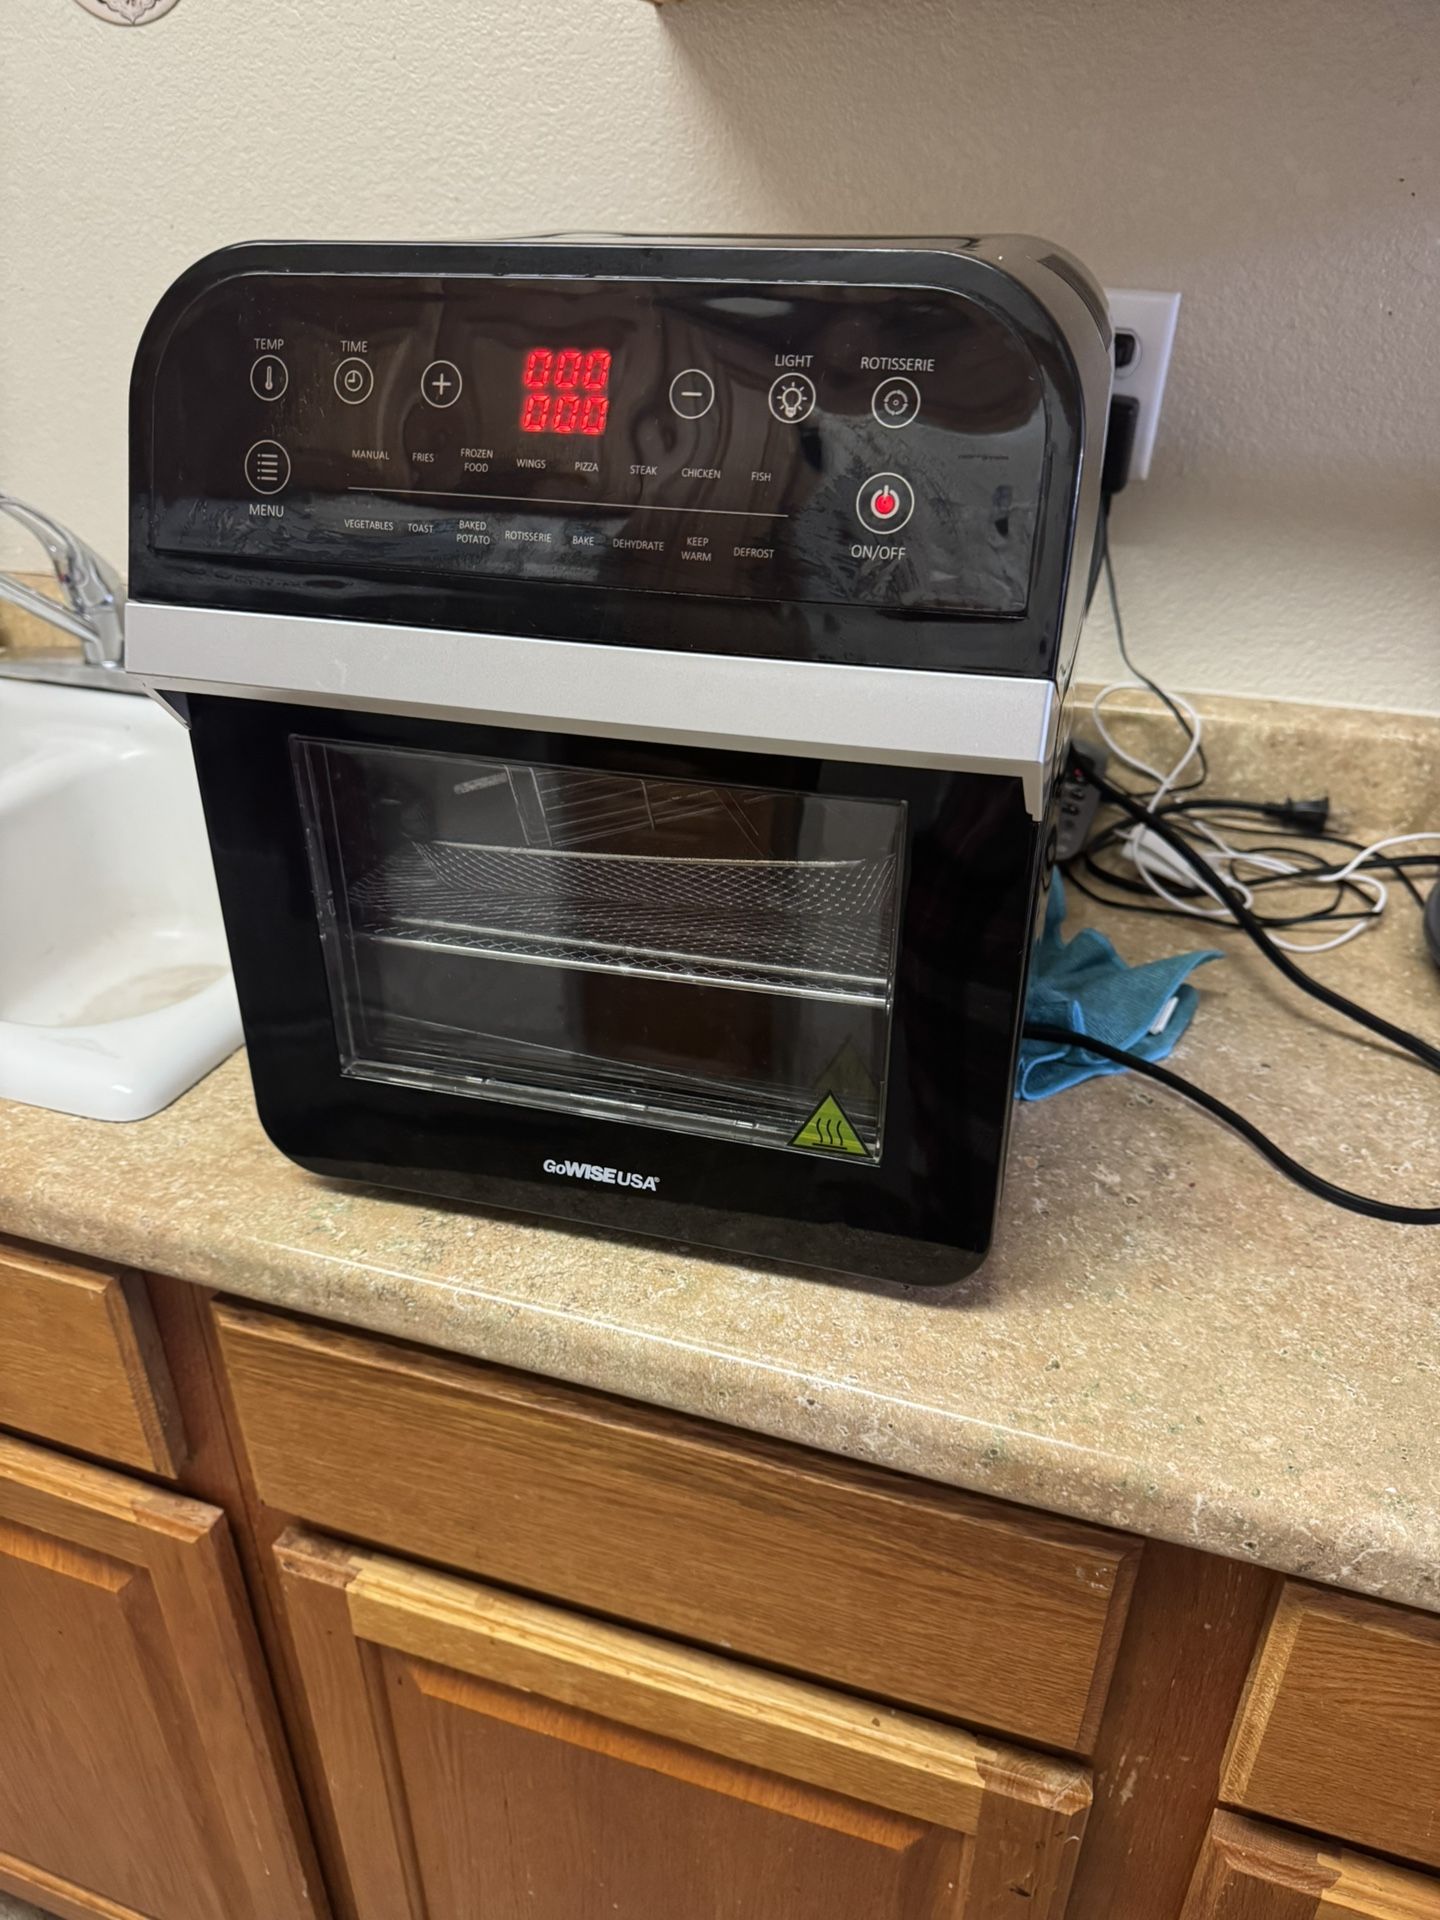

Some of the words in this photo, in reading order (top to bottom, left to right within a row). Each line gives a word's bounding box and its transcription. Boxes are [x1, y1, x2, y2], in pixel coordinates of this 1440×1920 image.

[253, 338, 285, 350] TEMP
[340, 341, 368, 353] TIME
[774, 355, 814, 368] LIGHT
[860, 357, 935, 372] ROTISSERIE
[351, 450, 390, 461] MANUAL
[412, 453, 435, 463] FRIES
[460, 448, 494, 459] FROZEN
[464, 463, 489, 473] FOOD
[516, 459, 546, 469] WINGS
[574, 462, 599, 472] PIZZA
[629, 465, 658, 476] STEAK
[681, 468, 721, 479] CHICKEN
[750, 472, 772, 482] FISH
[248, 504, 285, 518] MENU
[343, 519, 394, 531] VEGETABLES
[407, 523, 434, 534] TOAST
[458, 519, 487, 531] BAKED
[456, 534, 491, 545] POTATO
[504, 530, 553, 544] ROTISSERIE
[572, 536, 595, 547] BAKE
[686, 537, 709, 547] KEEP
[612, 538, 665, 551] DEHYDRATE
[680, 552, 712, 562] WARM
[733, 547, 775, 559] DEFROST
[850, 545, 907, 561] ON/OFF
